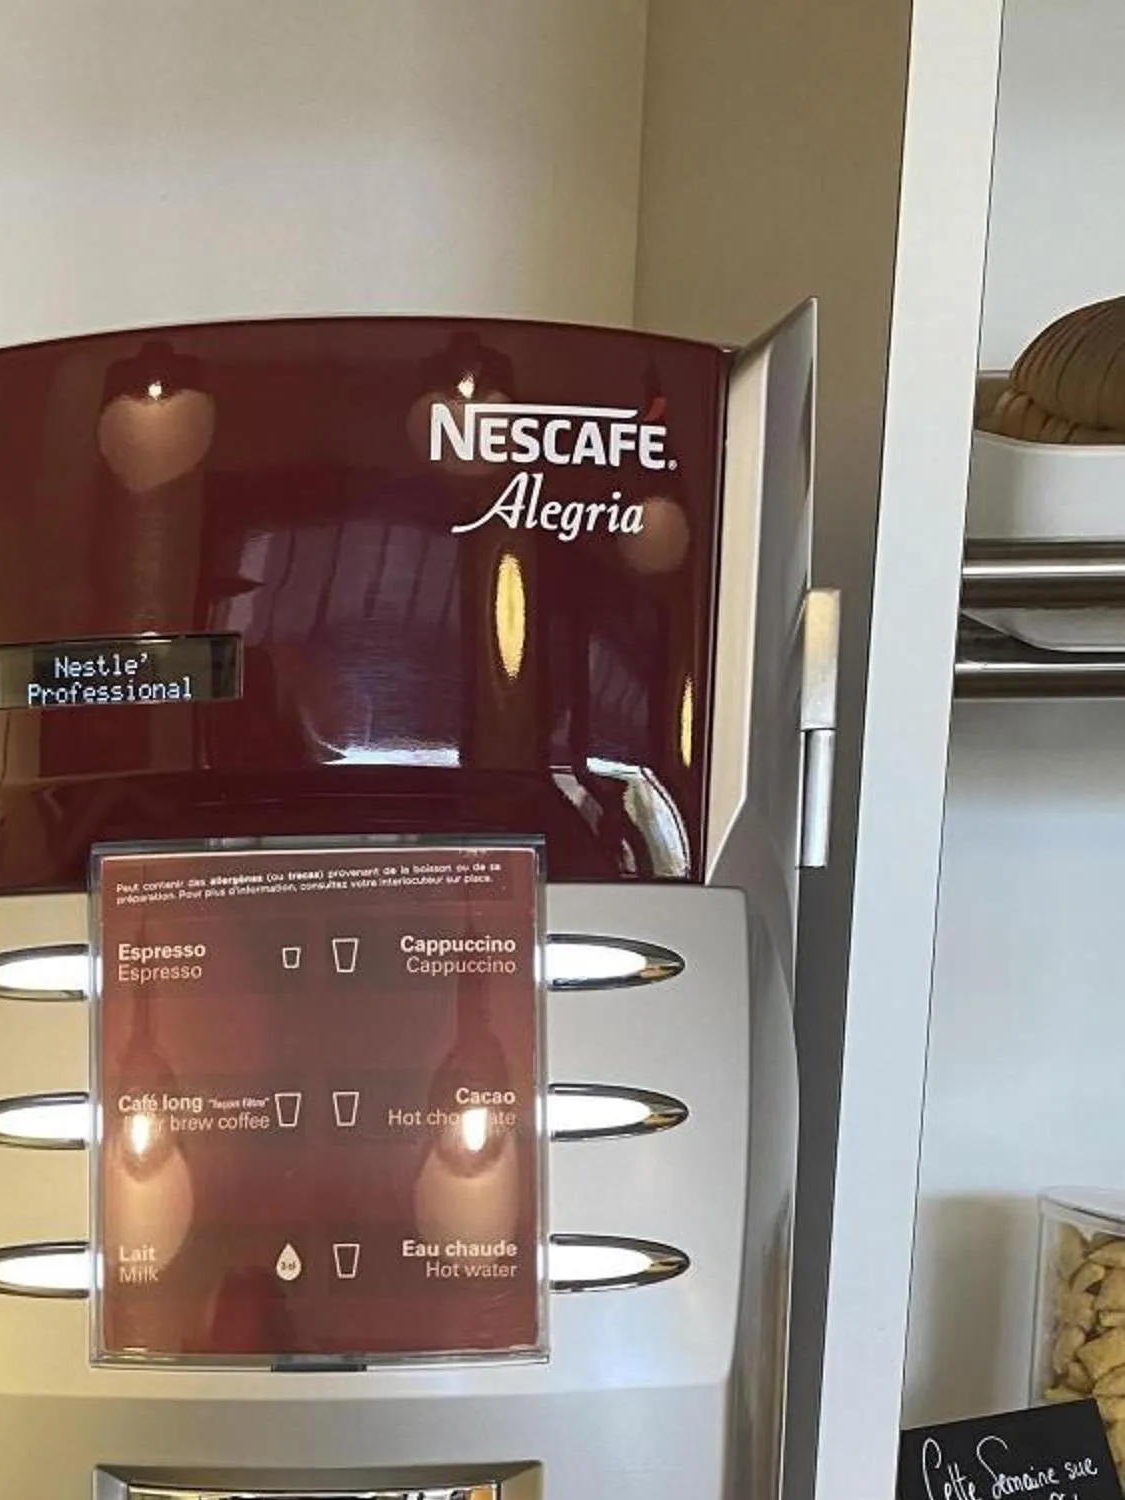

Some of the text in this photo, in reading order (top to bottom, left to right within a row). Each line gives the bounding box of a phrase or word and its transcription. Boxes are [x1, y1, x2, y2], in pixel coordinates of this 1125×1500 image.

[451, 471, 645, 542] Alegria
[27, 676, 193, 708] Professional
[116, 883, 140, 893] Peut
[142, 880, 184, 891] contenir
[188, 878, 206, 888] des
[266, 871, 284, 884] (ou
[327, 867, 379, 879] provenant
[382, 865, 397, 875] de
[400, 864, 410, 874] la
[413, 863, 452, 874] boisson
[456, 864, 470, 873] ou
[472, 862, 487, 872] de
[489, 863, 502, 872] sa
[178, 889, 202, 901] Pour
[204, 888, 226, 900] plus
[300, 879, 349, 892] consultez
[350, 877, 377, 889] votre
[379, 874, 443, 887] interlocuteur
[446, 875, 462, 884] sur
[118, 943, 207, 964] Espresso
[400, 935, 516, 957] Cappuccino
[118, 963, 203, 984] Espresso
[406, 955, 516, 977] Cappuccino
[118, 1093, 158, 1112] Café
[162, 1093, 203, 1113] long
[455, 1087, 516, 1105] Cacao
[170, 1113, 214, 1131] brew
[218, 1111, 271, 1129] coffee
[388, 1108, 516, 1126] Hot choate
[118, 1245, 156, 1262] Lait
[402, 1239, 518, 1257] Eau chaude
[118, 1265, 159, 1283] Milk
[426, 1261, 518, 1278] Hot water
